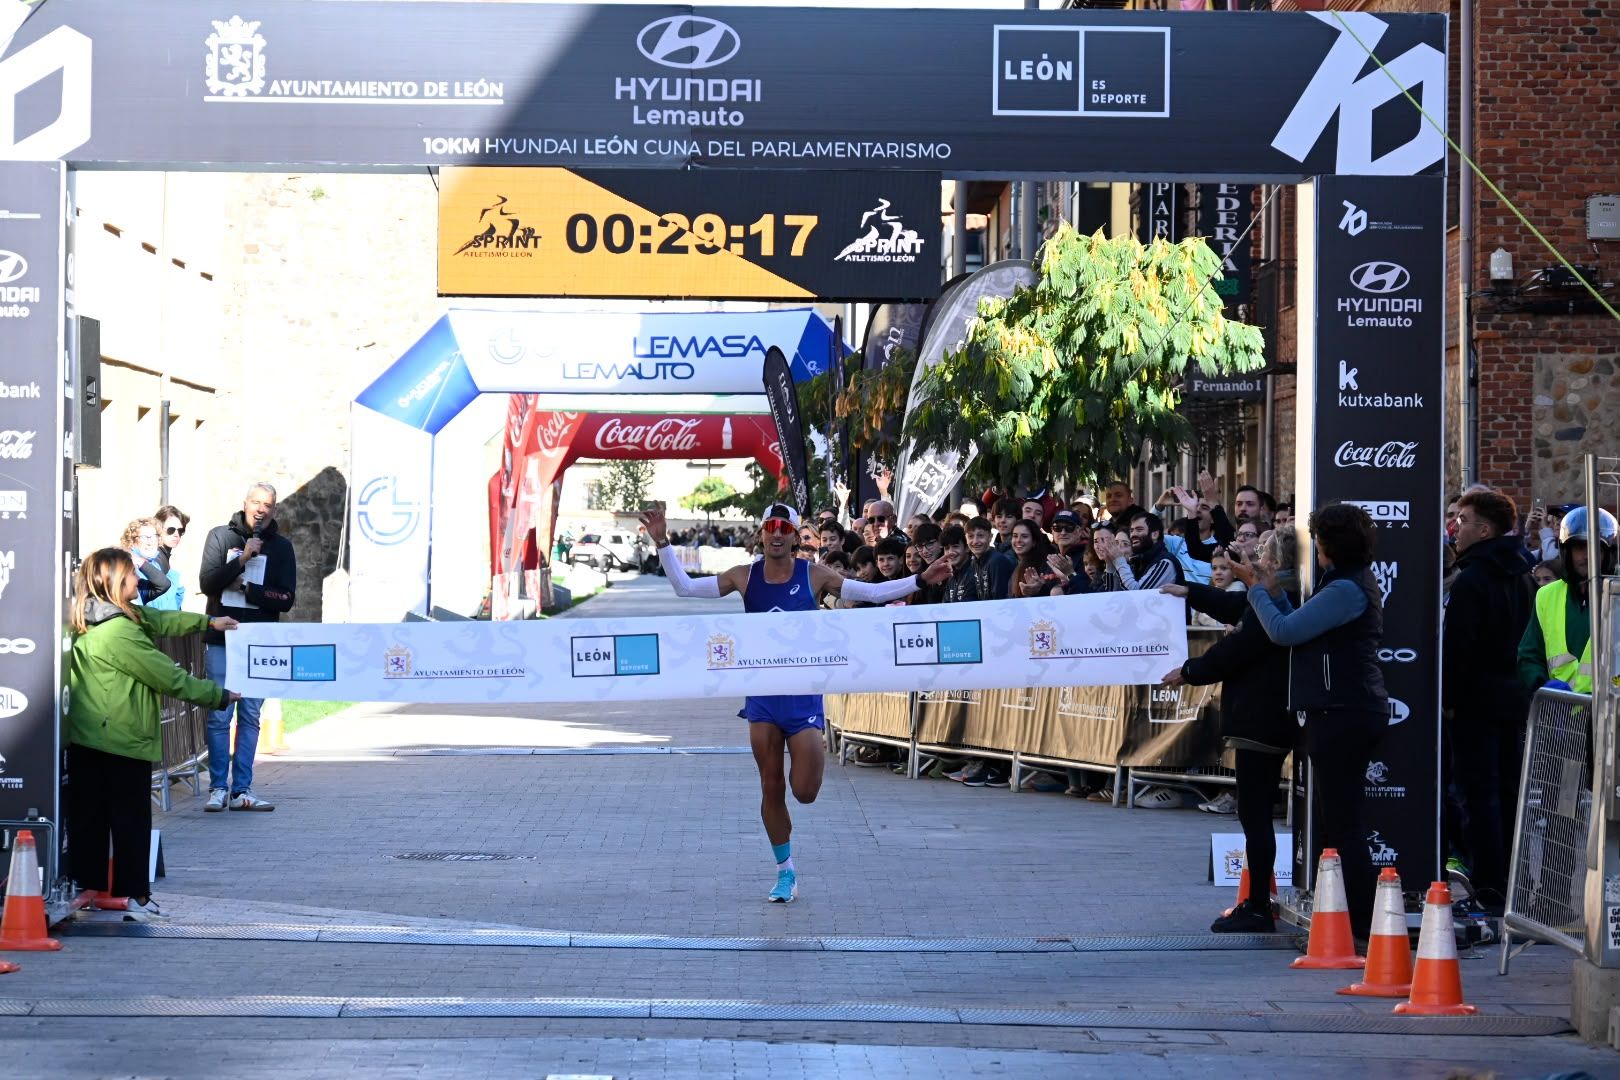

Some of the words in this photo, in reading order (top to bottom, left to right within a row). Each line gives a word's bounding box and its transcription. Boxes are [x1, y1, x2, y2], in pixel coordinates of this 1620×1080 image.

[1004, 53, 1073, 82] LEÓN
[269, 79, 418, 97] AYUNTAMIENTO
[423, 81, 450, 97] DE
[454, 79, 504, 98] LEÓN
[615, 77, 762, 102] HYUNDAI
[1091, 80, 1106, 91] ES
[1091, 93, 1147, 105] DEPORTE
[633, 105, 745, 127] Lemauto
[423, 137, 480, 154] 10KM
[485, 138, 578, 154] HYUNDAI
[584, 135, 638, 155] LEÓN
[643, 140, 702, 156] CUNA
[708, 141, 746, 157] DEL
[752, 141, 952, 160] PARLAMENTARISMO
[565, 213, 818, 257] 00:29:17
[845, 254, 892, 262] ATLETISMO
[1337, 298, 1422, 313] HYUNDAI
[1347, 315, 1413, 328] Lemauto
[633, 335, 768, 358] LEMASA
[562, 362, 695, 380] LEMAUTO
[1193, 380, 1254, 391] Fernando
[1338, 392, 1424, 408] kutxabank
[595, 418, 703, 451] Coca-Cola
[1334, 440, 1419, 469] Coca-Cola
[1359, 504, 1407, 517] EON
[899, 634, 934, 649] LEÓN
[576, 648, 611, 662] LEÓN
[1059, 647, 1128, 656] AYUNTAMIENTO
[1131, 645, 1143, 653] DE
[1145, 643, 1170, 653] LEÓN
[253, 655, 288, 667] LEÓN
[737, 657, 808, 666] AYUNTAMIENTO
[824, 653, 849, 663] LEÓN
[501, 667, 526, 675] LEÓN
